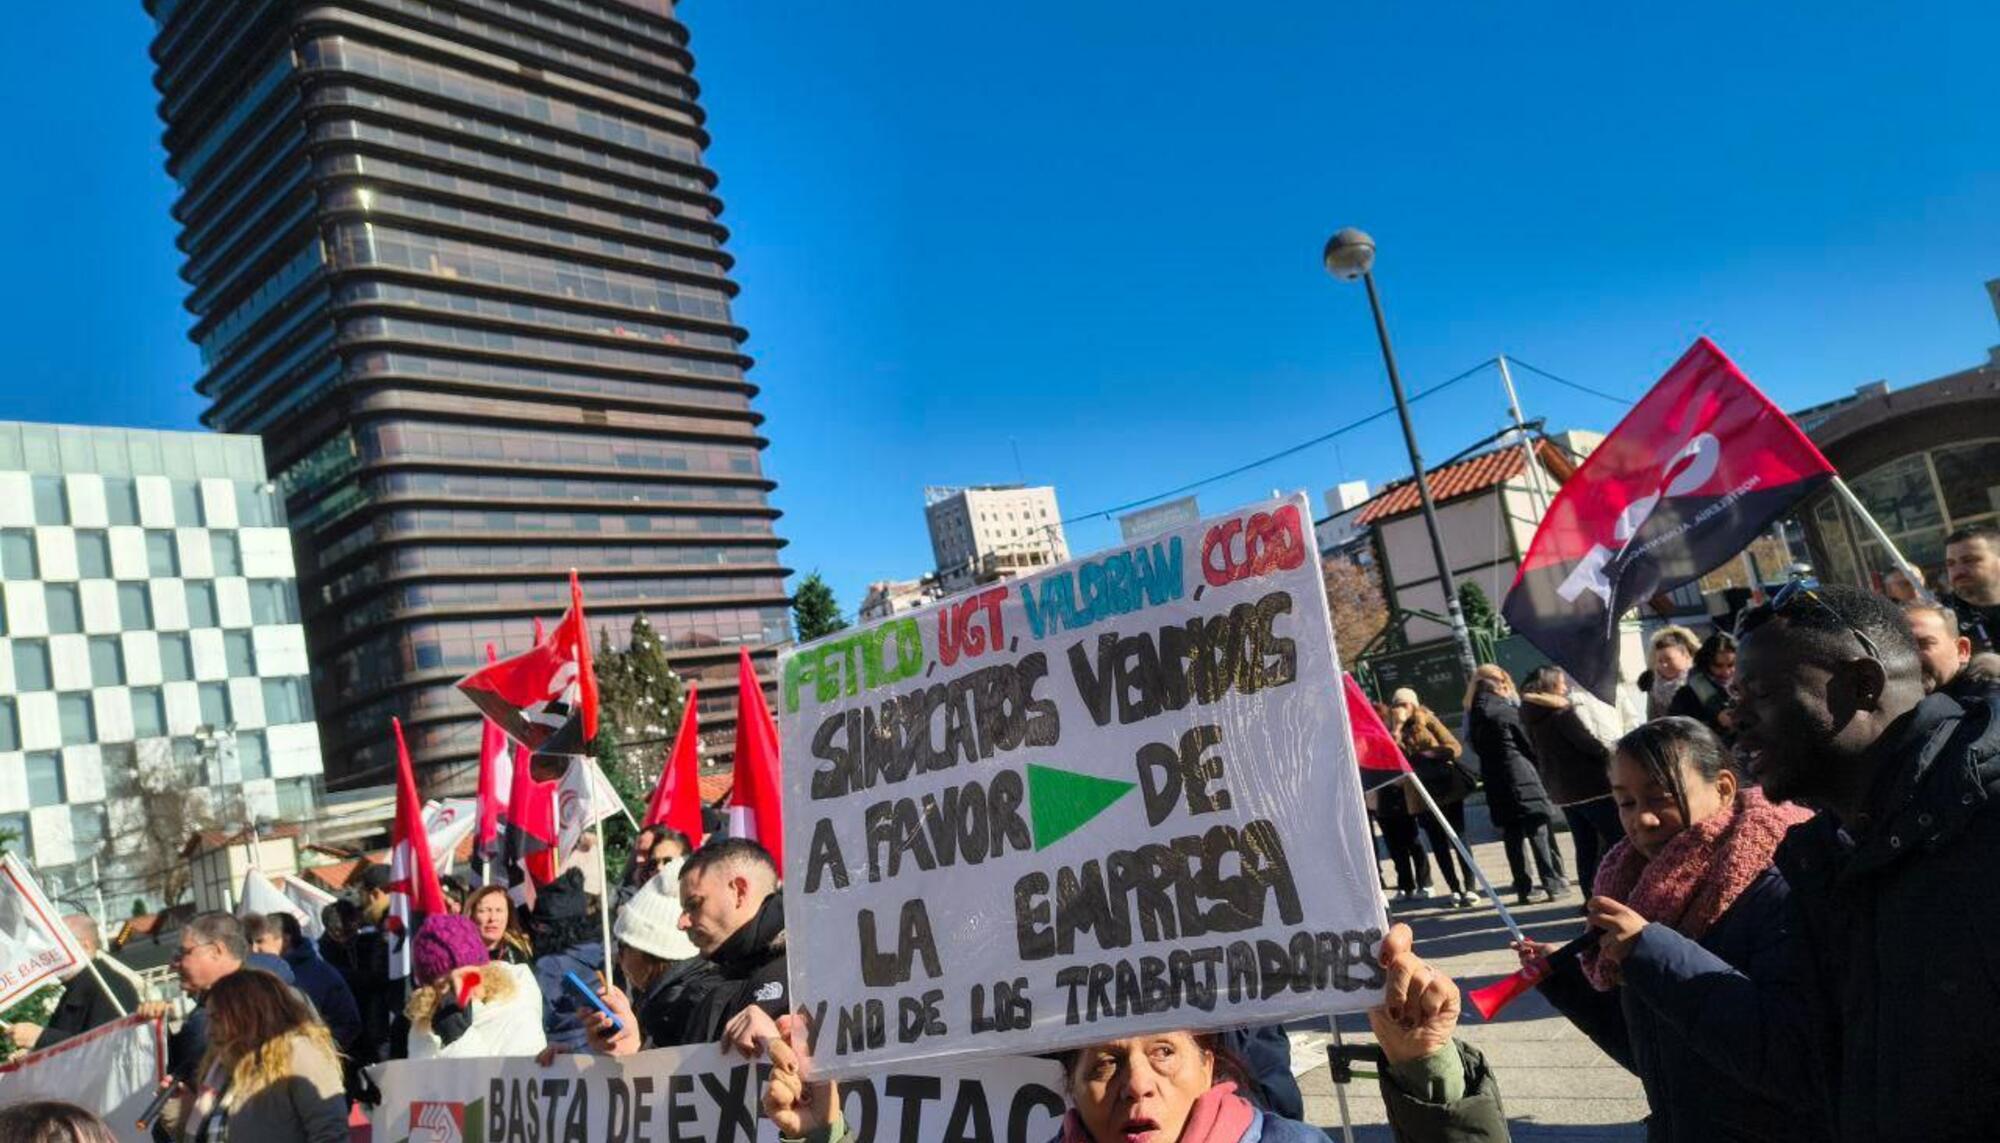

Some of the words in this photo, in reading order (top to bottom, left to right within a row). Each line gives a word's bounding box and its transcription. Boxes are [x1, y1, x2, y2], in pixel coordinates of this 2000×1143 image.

[1201, 505, 1305, 587] CCOO
[811, 651, 1060, 800] SINDICATOS
[1067, 591, 1298, 727] VENDIDOS
[804, 817, 849, 894] A
[864, 769, 1031, 882] FAVOR
[1136, 725, 1232, 827] DE
[18, 950, 63, 978] BASE
[858, 899, 942, 987] LA
[1015, 819, 1303, 960] EMPRESA
[797, 1000, 828, 1057] Y
[836, 999, 886, 1055] NO
[898, 989, 948, 1043] DE
[970, 977, 1032, 1034] LOS
[1056, 928, 1387, 1025] TRABAJADORES
[488, 1077, 588, 1143] BASTA
[606, 1076, 653, 1143] DE
[667, 1064, 1065, 1143] EXOTAC
